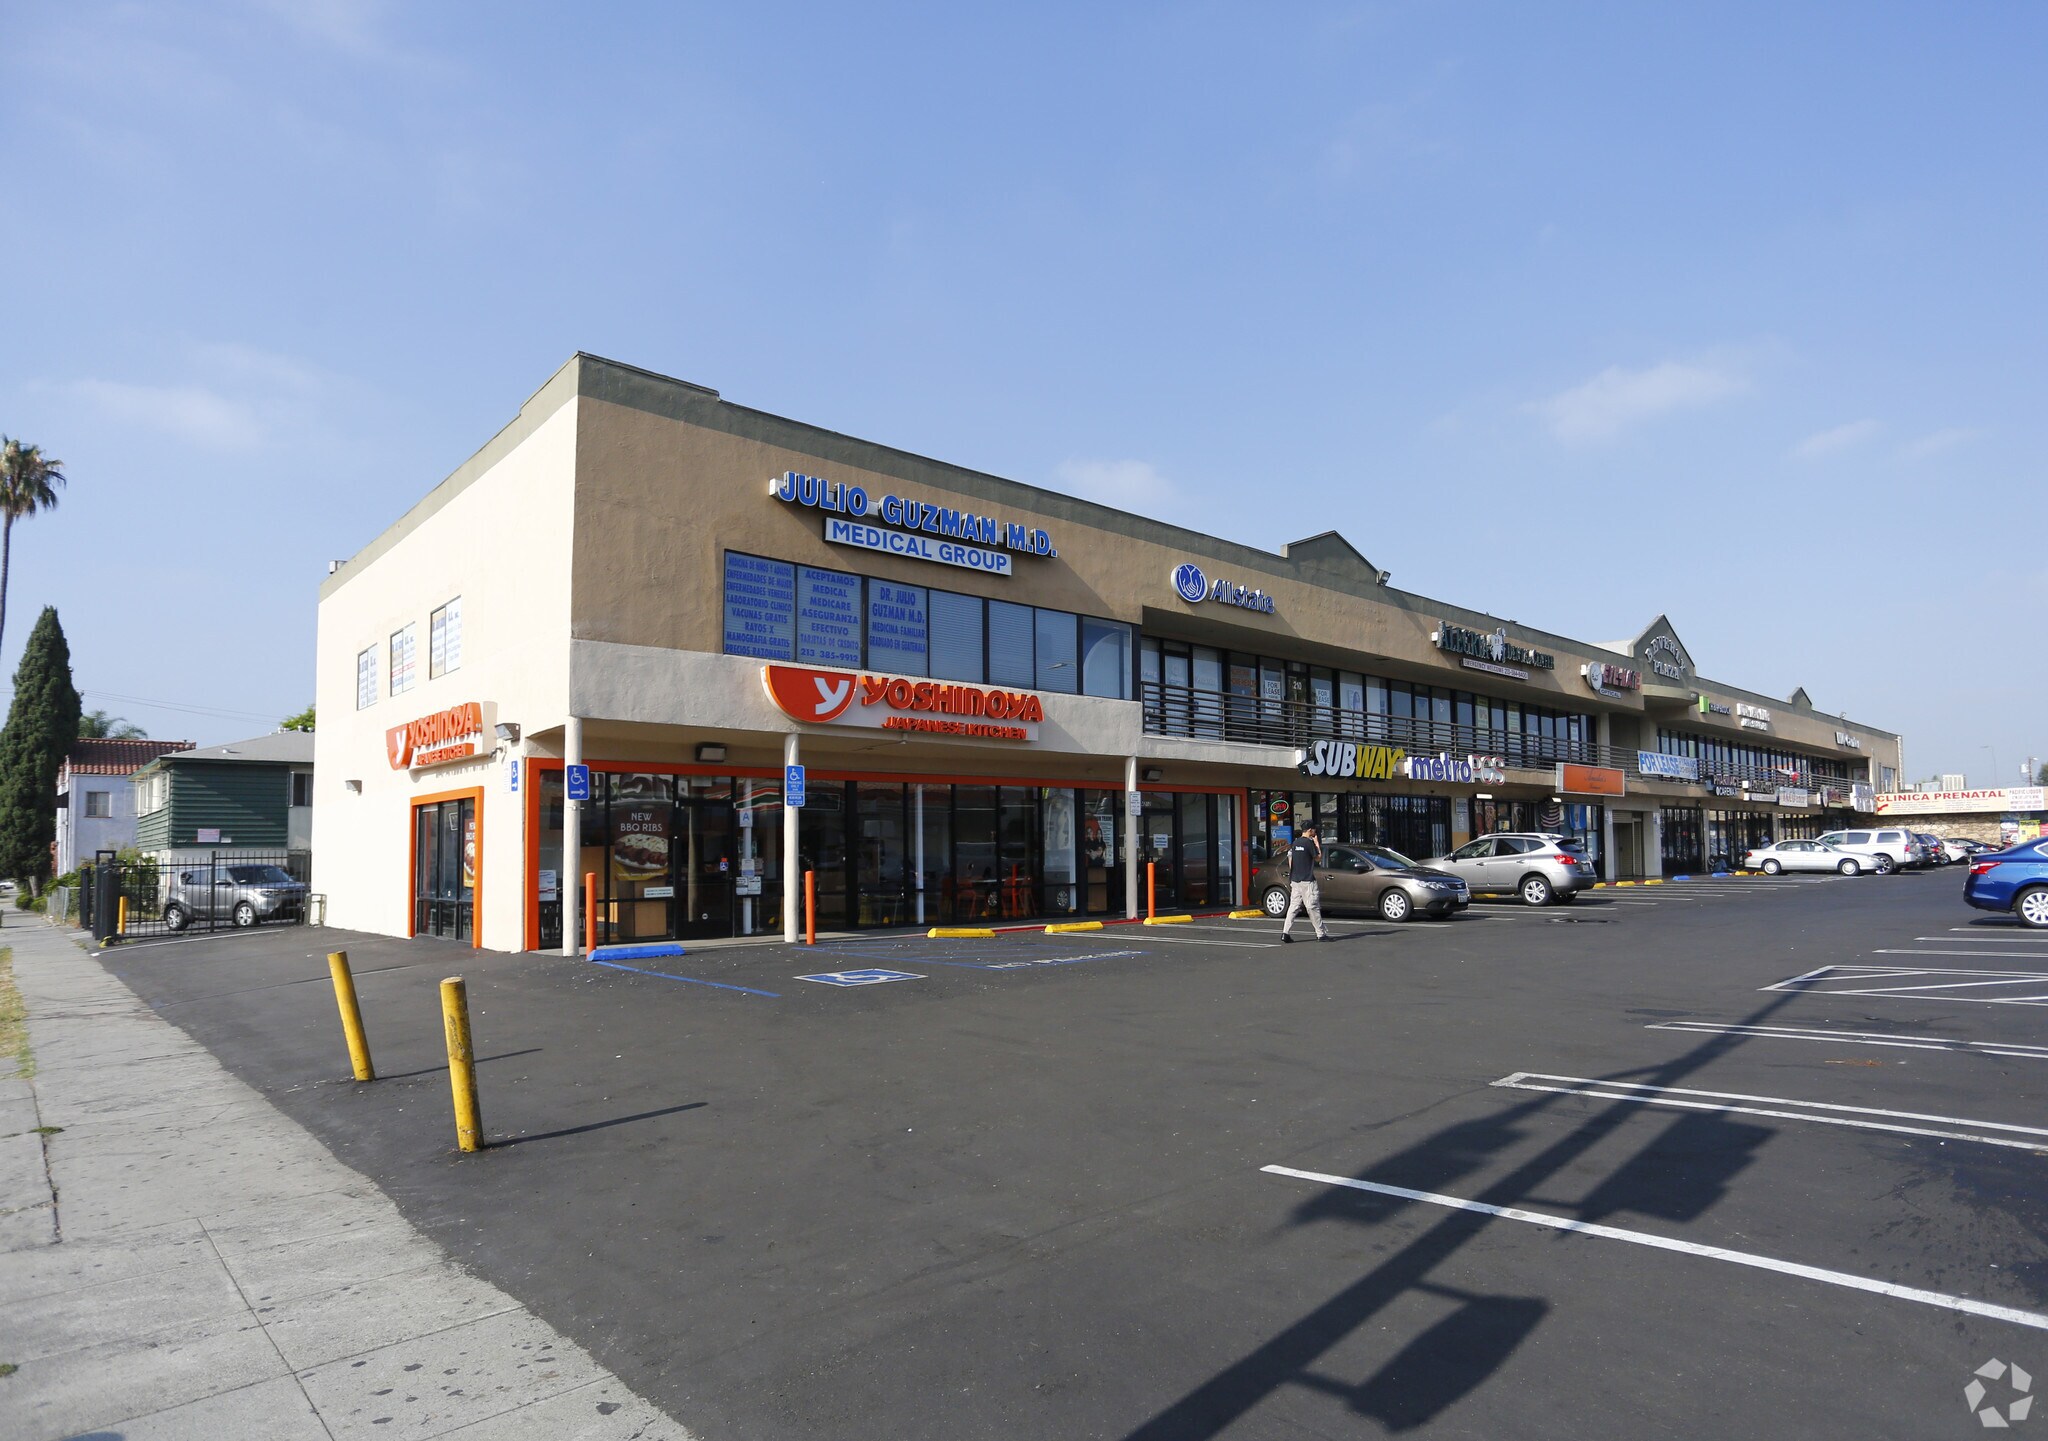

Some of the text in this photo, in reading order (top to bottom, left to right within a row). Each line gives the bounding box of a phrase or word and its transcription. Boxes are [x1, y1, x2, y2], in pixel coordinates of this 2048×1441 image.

[778, 471, 1058, 558] JULIO GUZMAN M.D.
[832, 521, 1007, 571] MEDICAL GROUP
[727, 569, 766, 584] ENFERMEDADES
[805, 570, 855, 586] ACEPTAMOS
[727, 581, 766, 595] ENFERMEDADES
[812, 584, 847, 597] MEDICAL
[727, 593, 768, 608] LABORATORIO
[810, 596, 851, 611] MEDICARE
[880, 587, 916, 606] DR. JULIO
[1210, 579, 1275, 614] Allstate
[732, 607, 788, 624] VACUNAS GRATIS
[802, 608, 858, 624] ASEGURANZA
[872, 602, 925, 624] GUZMAN M.D.
[745, 621, 774, 634] RAYOS X
[811, 622, 849, 636] EFECTIVO
[872, 622, 925, 638] MEDICINA FAMILIAR
[726, 631, 790, 647] MAMOGRAFIA GRATIS
[725, 643, 750, 655] PRECIOS
[801, 648, 858, 662] 213 385-9912
[1645, 635, 1686, 672] BEVERLY
[1653, 660, 1680, 680] PLAZA
[861, 675, 1044, 722] YOSHINOYA
[1265, 687, 1280, 696] LEASE
[1317, 696, 1330, 704] LEASE
[407, 702, 479, 748] YOSHINOYA
[883, 717, 1027, 740] JAPANESE KITCHEN
[1306, 740, 1405, 780] SUBWAY
[1639, 753, 1656, 771] FOR
[1656, 755, 1679, 771] LEASE
[1877, 790, 2006, 802] CLINICA PRENATAL
[631, 812, 652, 821] NEW
[743, 812, 750, 821] A
[620, 823, 662, 831] BBQ RIBS
